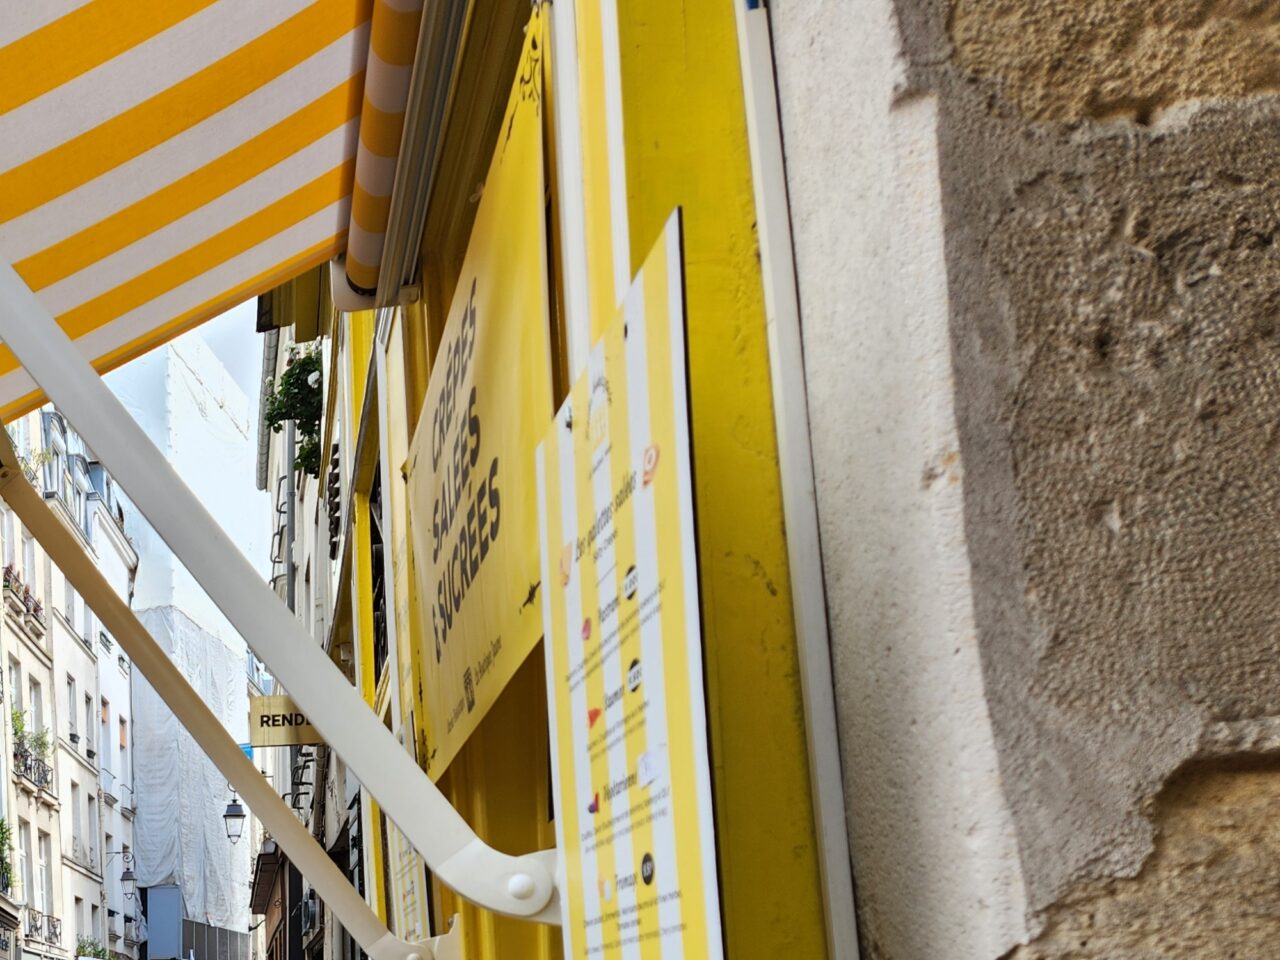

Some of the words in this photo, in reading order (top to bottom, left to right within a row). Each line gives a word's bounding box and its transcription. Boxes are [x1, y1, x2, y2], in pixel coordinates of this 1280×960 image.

[432, 276, 478, 475] CRÊPES
[433, 385, 480, 565] SALÉES
[436, 456, 501, 640] SUCRÉES
[260, 713, 312, 728] REND
